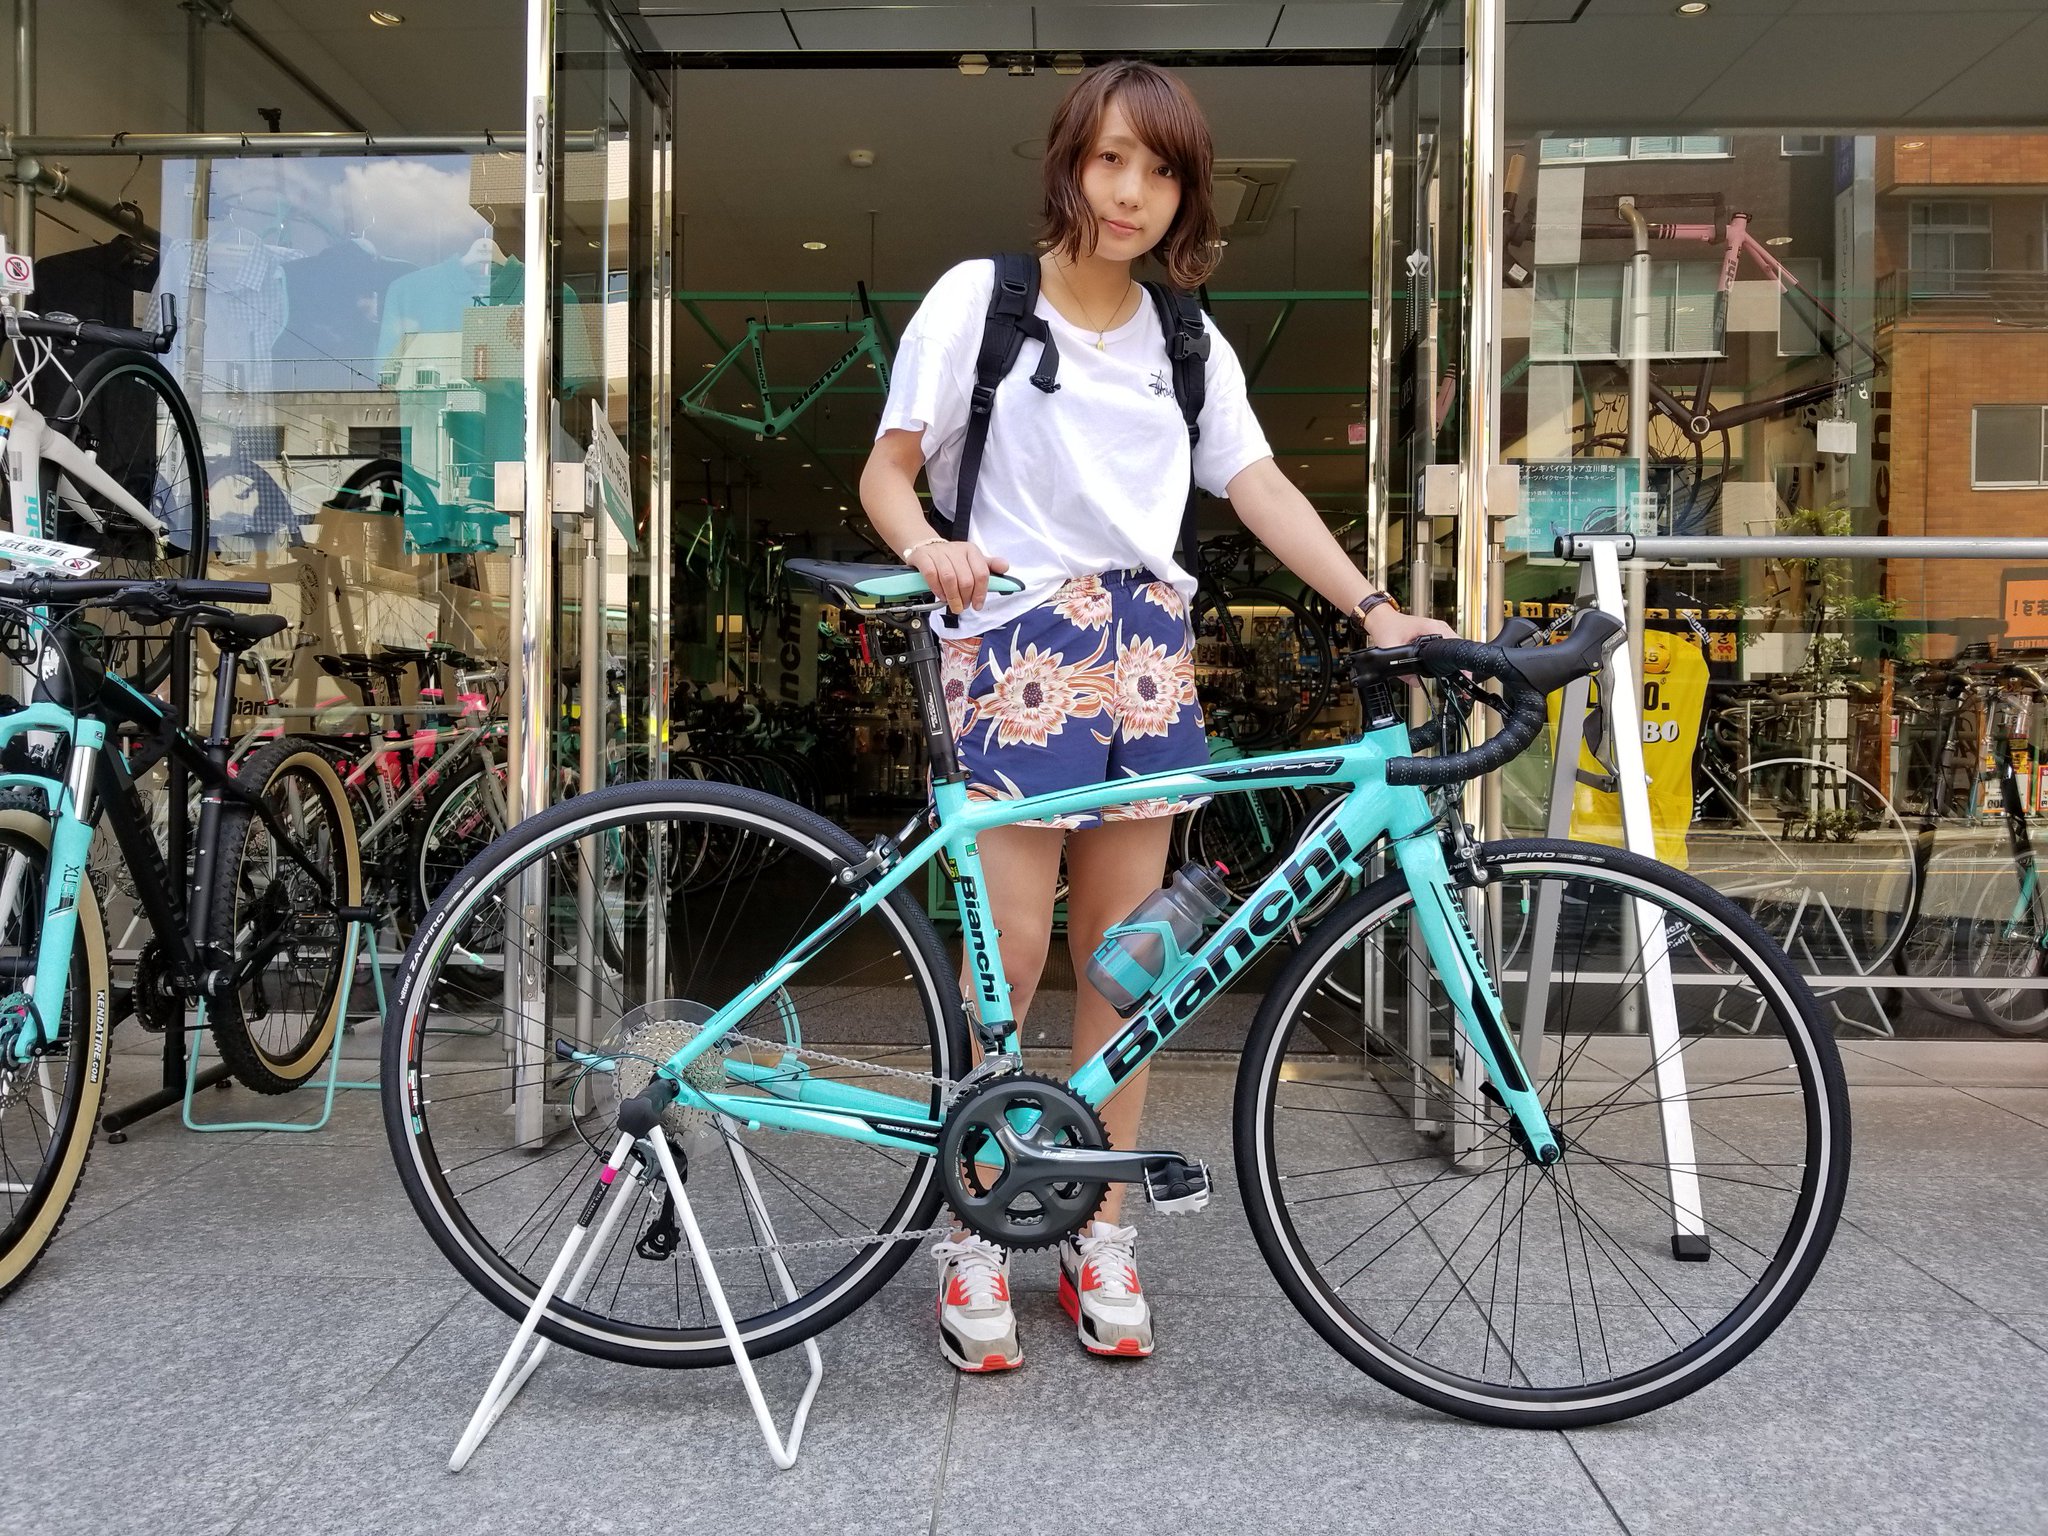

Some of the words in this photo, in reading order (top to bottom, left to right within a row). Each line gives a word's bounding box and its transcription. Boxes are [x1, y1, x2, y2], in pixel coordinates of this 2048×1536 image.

[1486, 851, 1556, 863] ZAFFIRO
[408, 911, 446, 973] ZAFFIRO
[961, 875, 1001, 1003] Bianchi
[1103, 820, 1353, 1085] Bianchi
[1443, 881, 1501, 998] Bianchi
[90, 990, 106, 1083] KENDATIRE.COM
